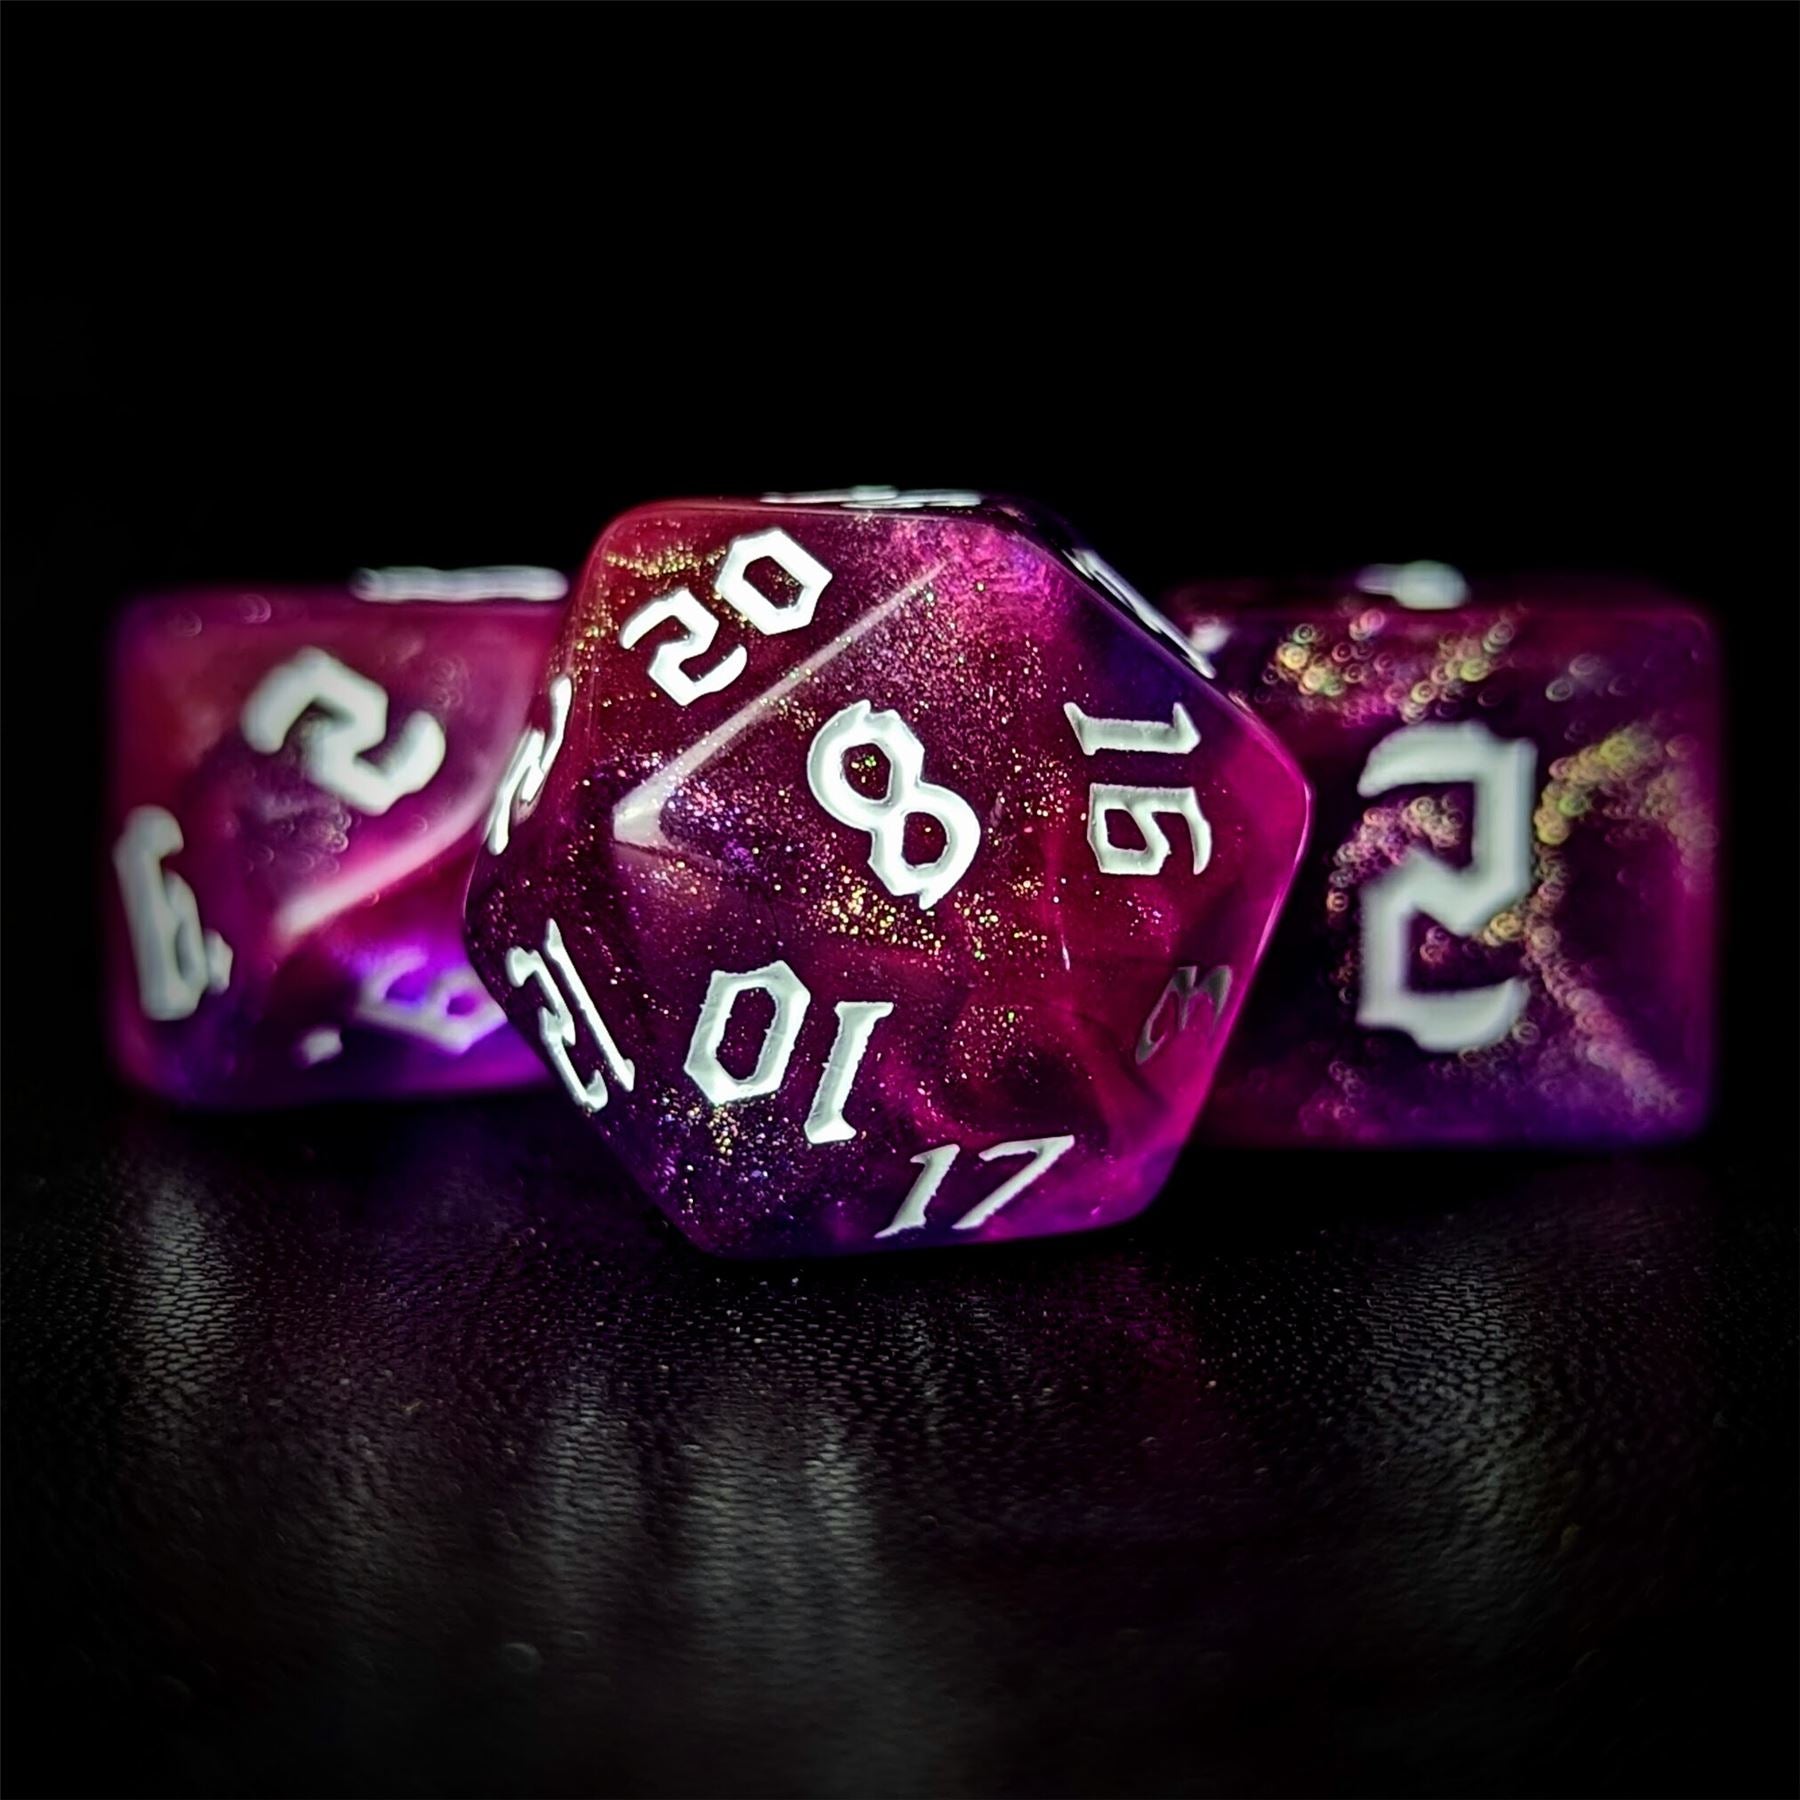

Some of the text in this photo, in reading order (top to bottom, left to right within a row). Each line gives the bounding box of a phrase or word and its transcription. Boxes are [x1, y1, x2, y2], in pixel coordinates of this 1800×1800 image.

[619, 527, 833, 707] 20
[242, 645, 446, 816] 2
[806, 699, 981, 911] 8
[1063, 701, 1214, 876] 16
[1356, 720, 1538, 1054] 2
[505, 918, 637, 1113] 12
[683, 960, 895, 1145] 10
[873, 1134, 1076, 1239] 17
